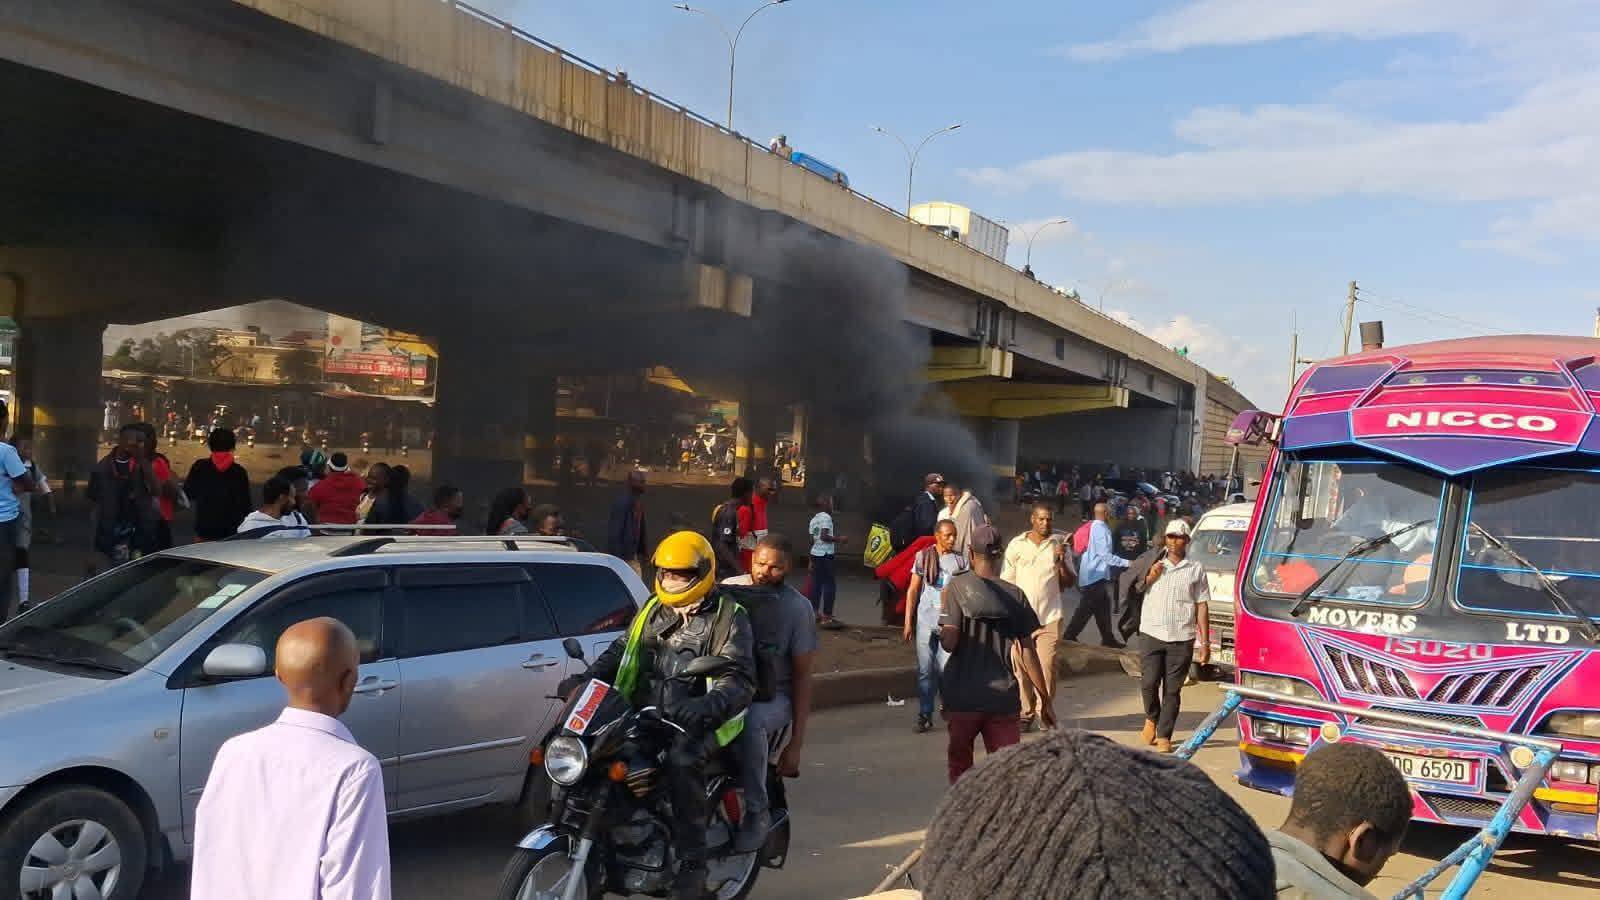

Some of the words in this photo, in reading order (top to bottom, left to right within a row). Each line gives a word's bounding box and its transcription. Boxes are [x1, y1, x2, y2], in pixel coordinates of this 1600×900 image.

[1386, 411, 1557, 432] NICCO
[1307, 607, 1417, 633] MOVERS
[1505, 622, 1570, 644] LTD
[1384, 637, 1493, 659] ISUZU
[1420, 760, 1465, 780] 659D
